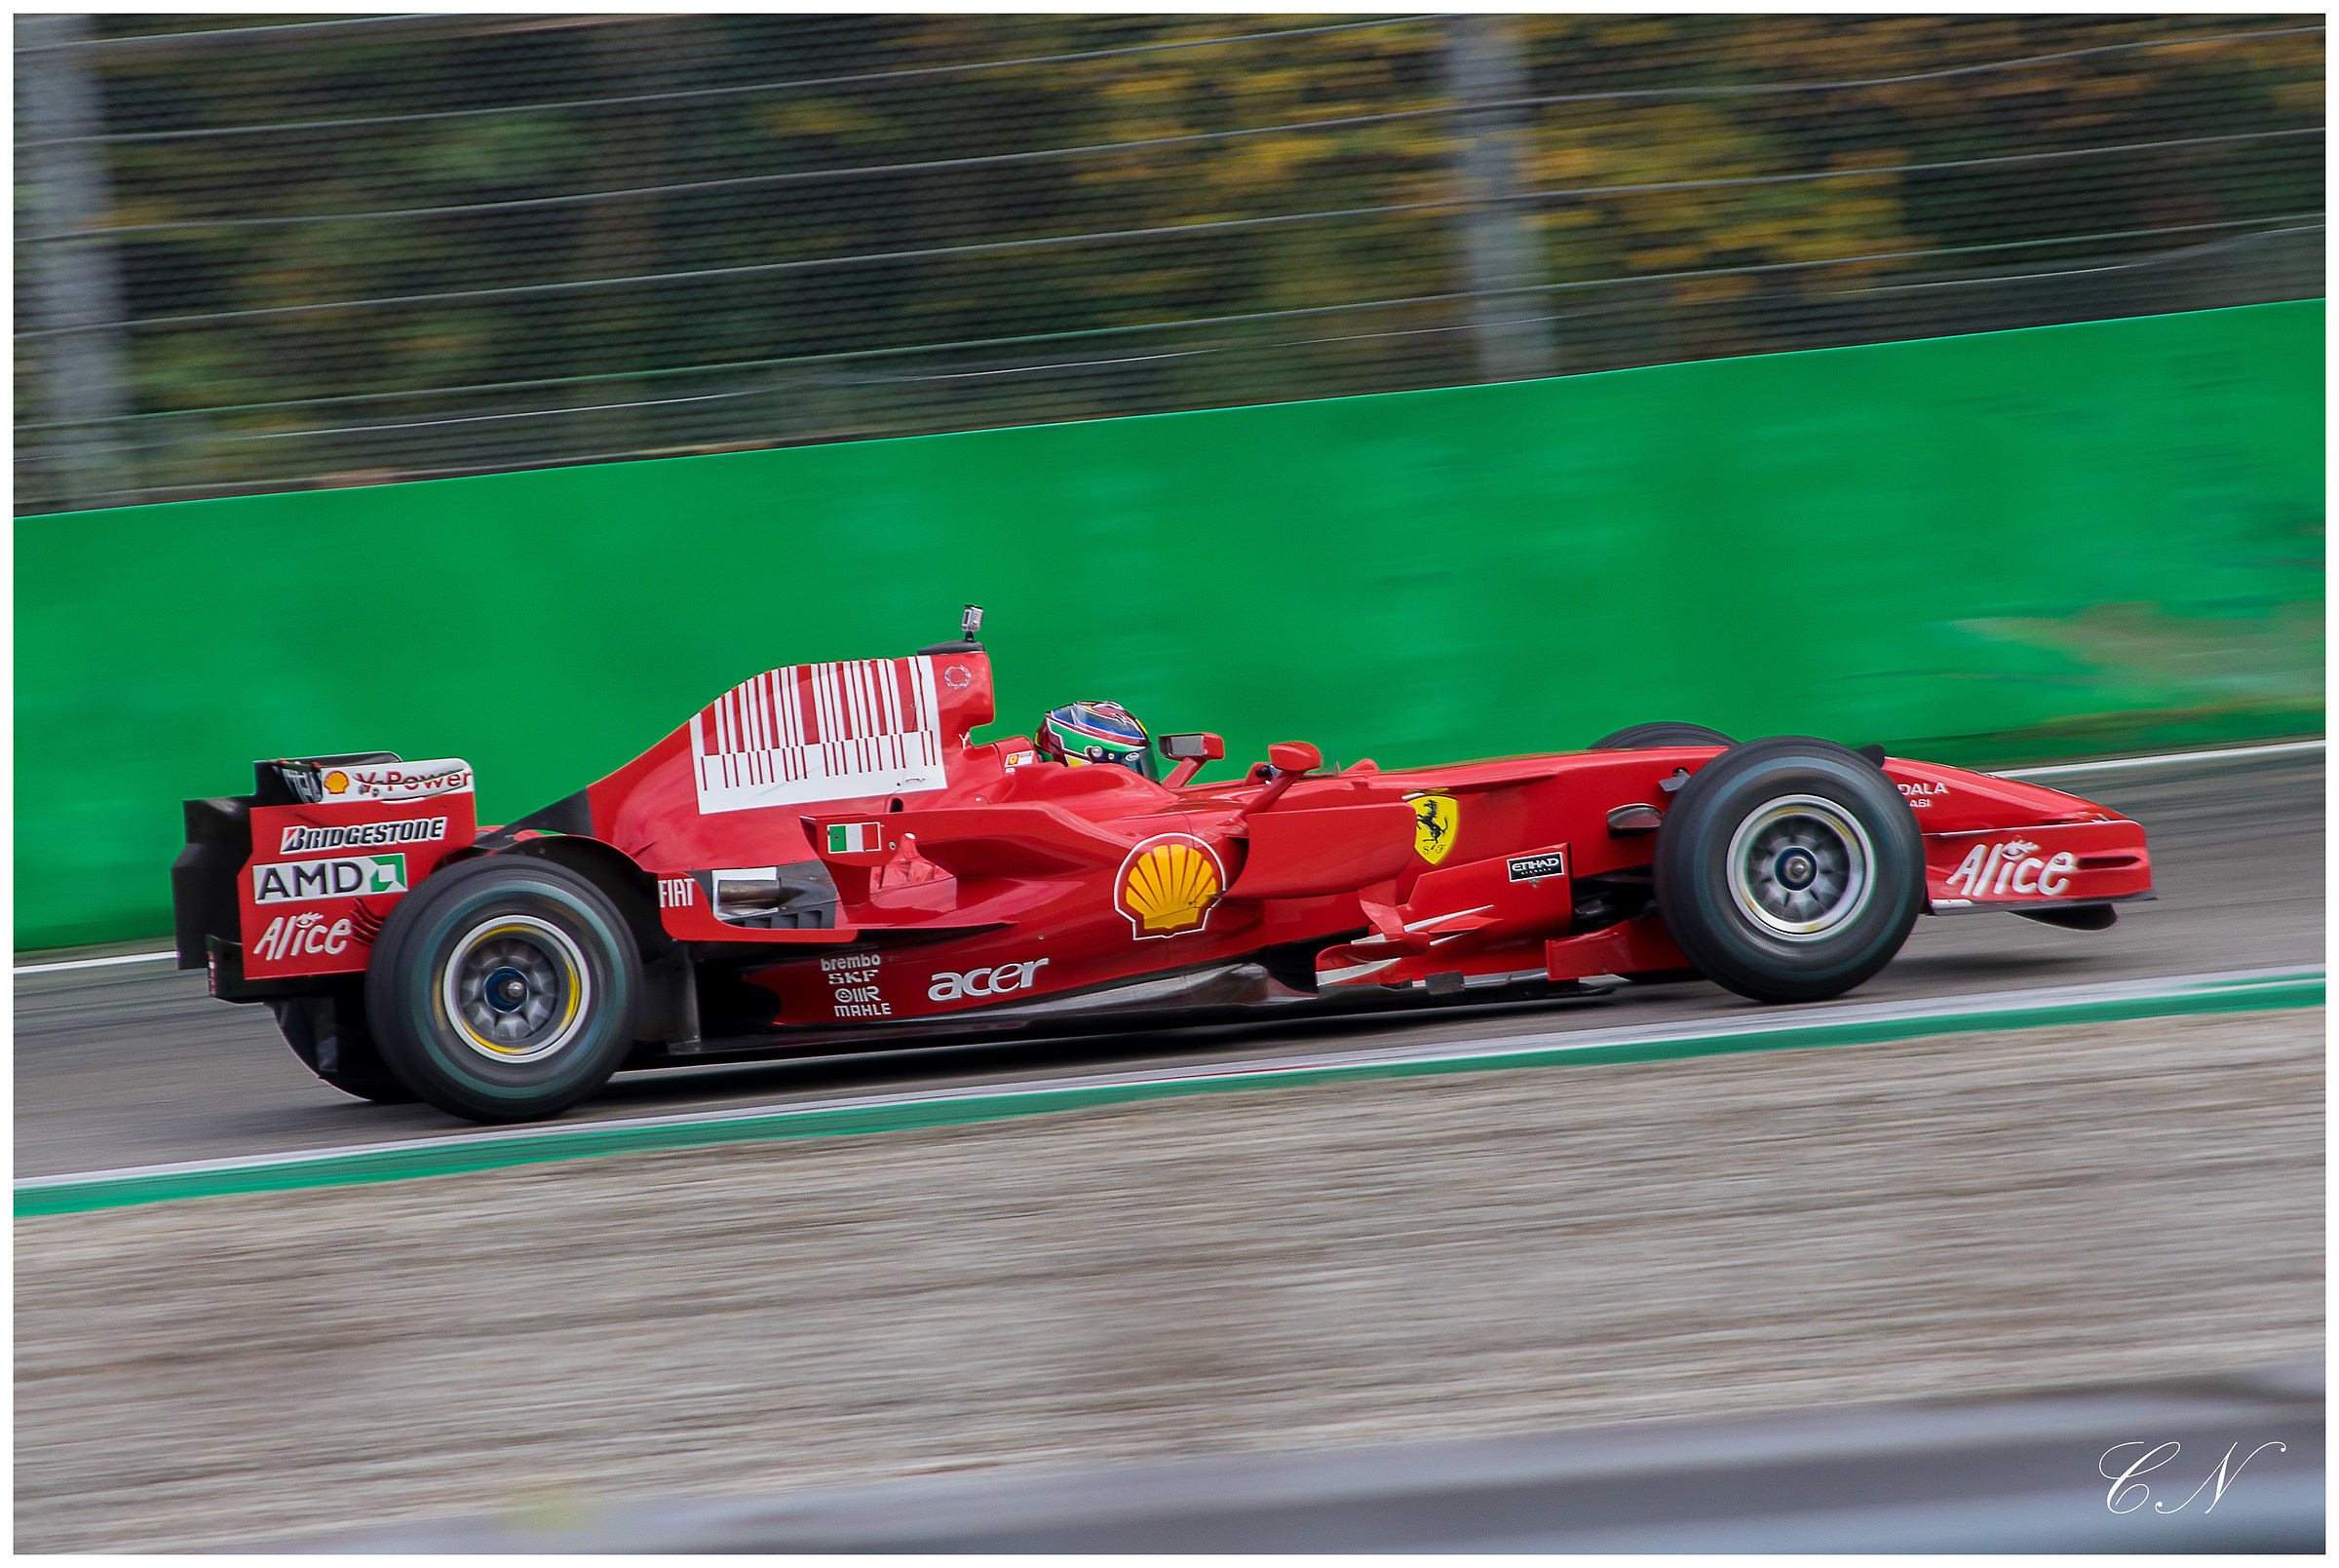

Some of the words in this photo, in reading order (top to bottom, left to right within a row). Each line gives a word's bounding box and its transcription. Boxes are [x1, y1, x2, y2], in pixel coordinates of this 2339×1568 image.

[356, 770, 474, 793] V-Power
[281, 817, 446, 854] BRIDGESTONE
[1512, 857, 1559, 872] ETIHAD
[1946, 838, 2078, 897] Alice
[257, 860, 364, 900] AMD
[658, 878, 695, 908] FIAT
[252, 912, 353, 961] Alice
[821, 954, 881, 972] brembo
[828, 970, 879, 984] SKF
[927, 957, 1050, 1002] acer
[833, 1003, 892, 1016] MAHLE
